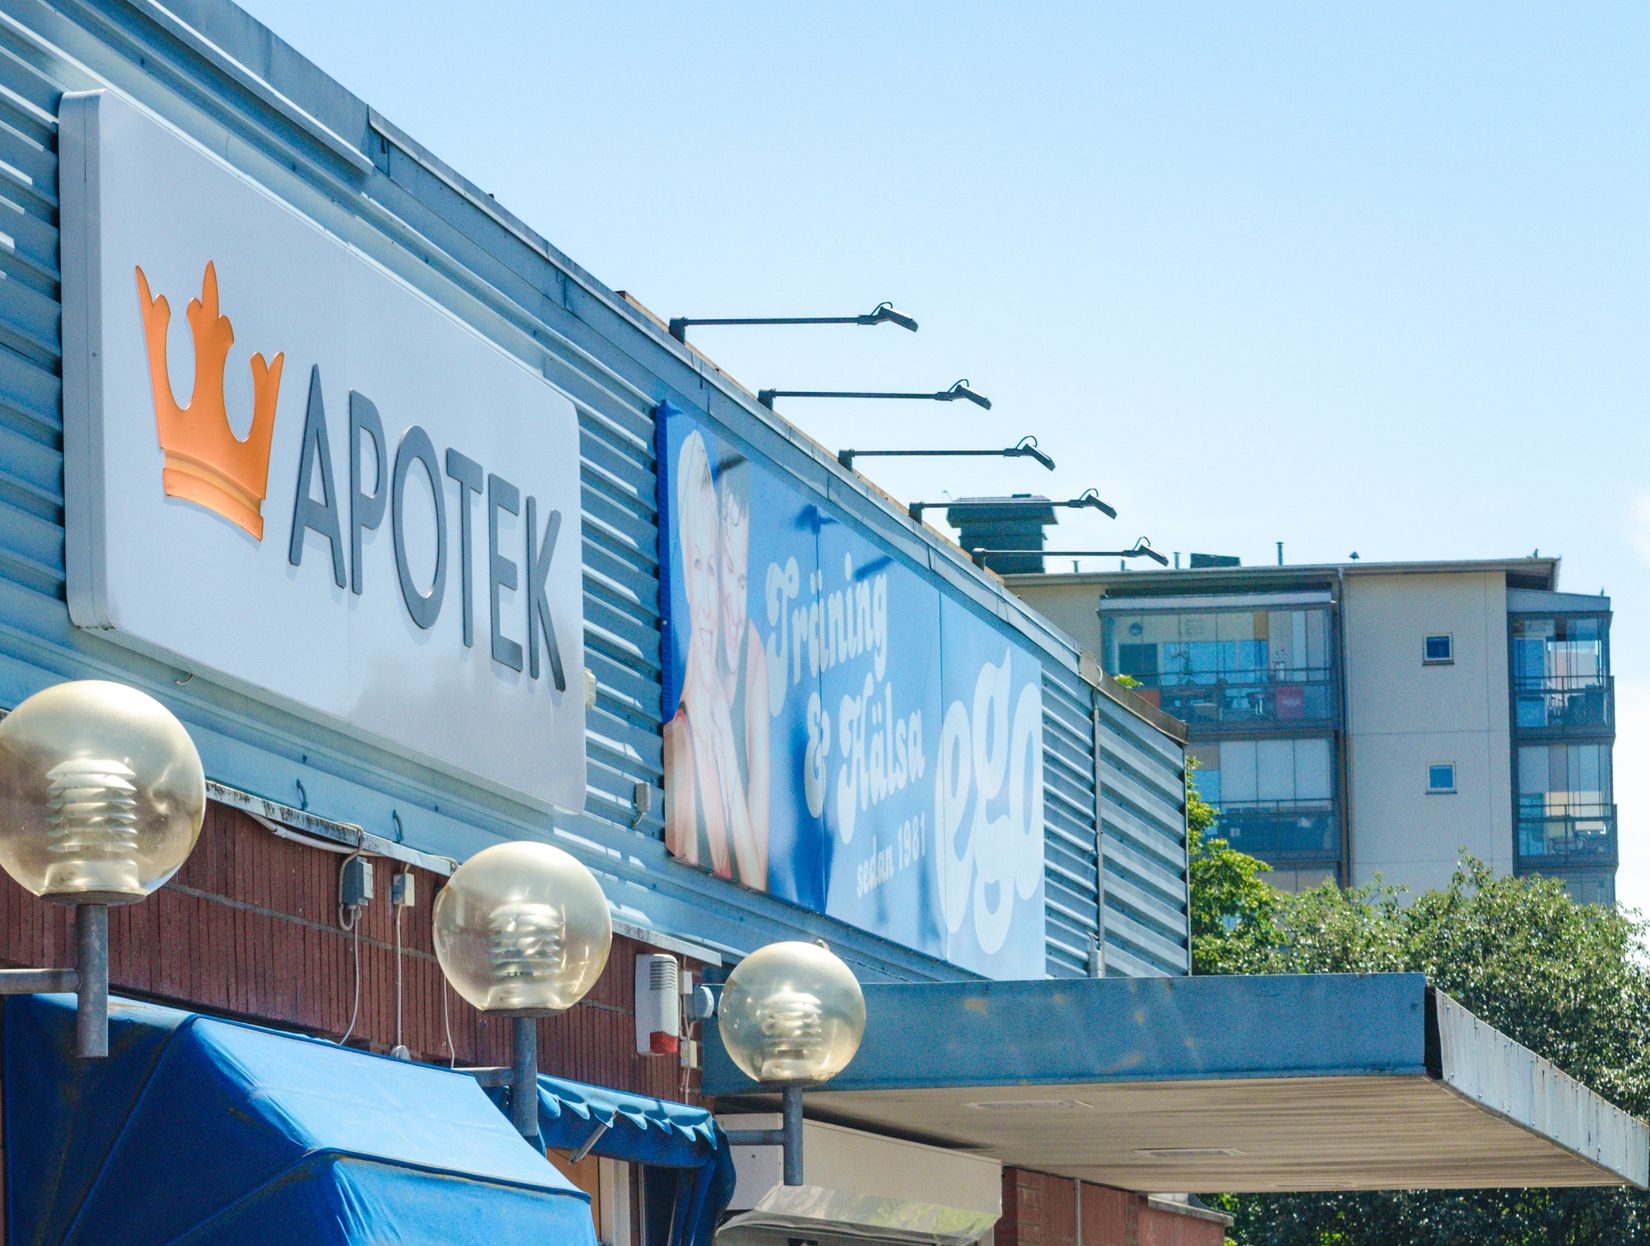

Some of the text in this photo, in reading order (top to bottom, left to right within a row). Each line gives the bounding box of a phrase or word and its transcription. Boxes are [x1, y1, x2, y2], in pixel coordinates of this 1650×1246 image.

[288, 362, 566, 693] APOTEK
[765, 551, 888, 717] Träning
[804, 672, 925, 844] & Hälsa
[934, 646, 1044, 955] ego
[857, 811, 927, 898] sedan 1981
